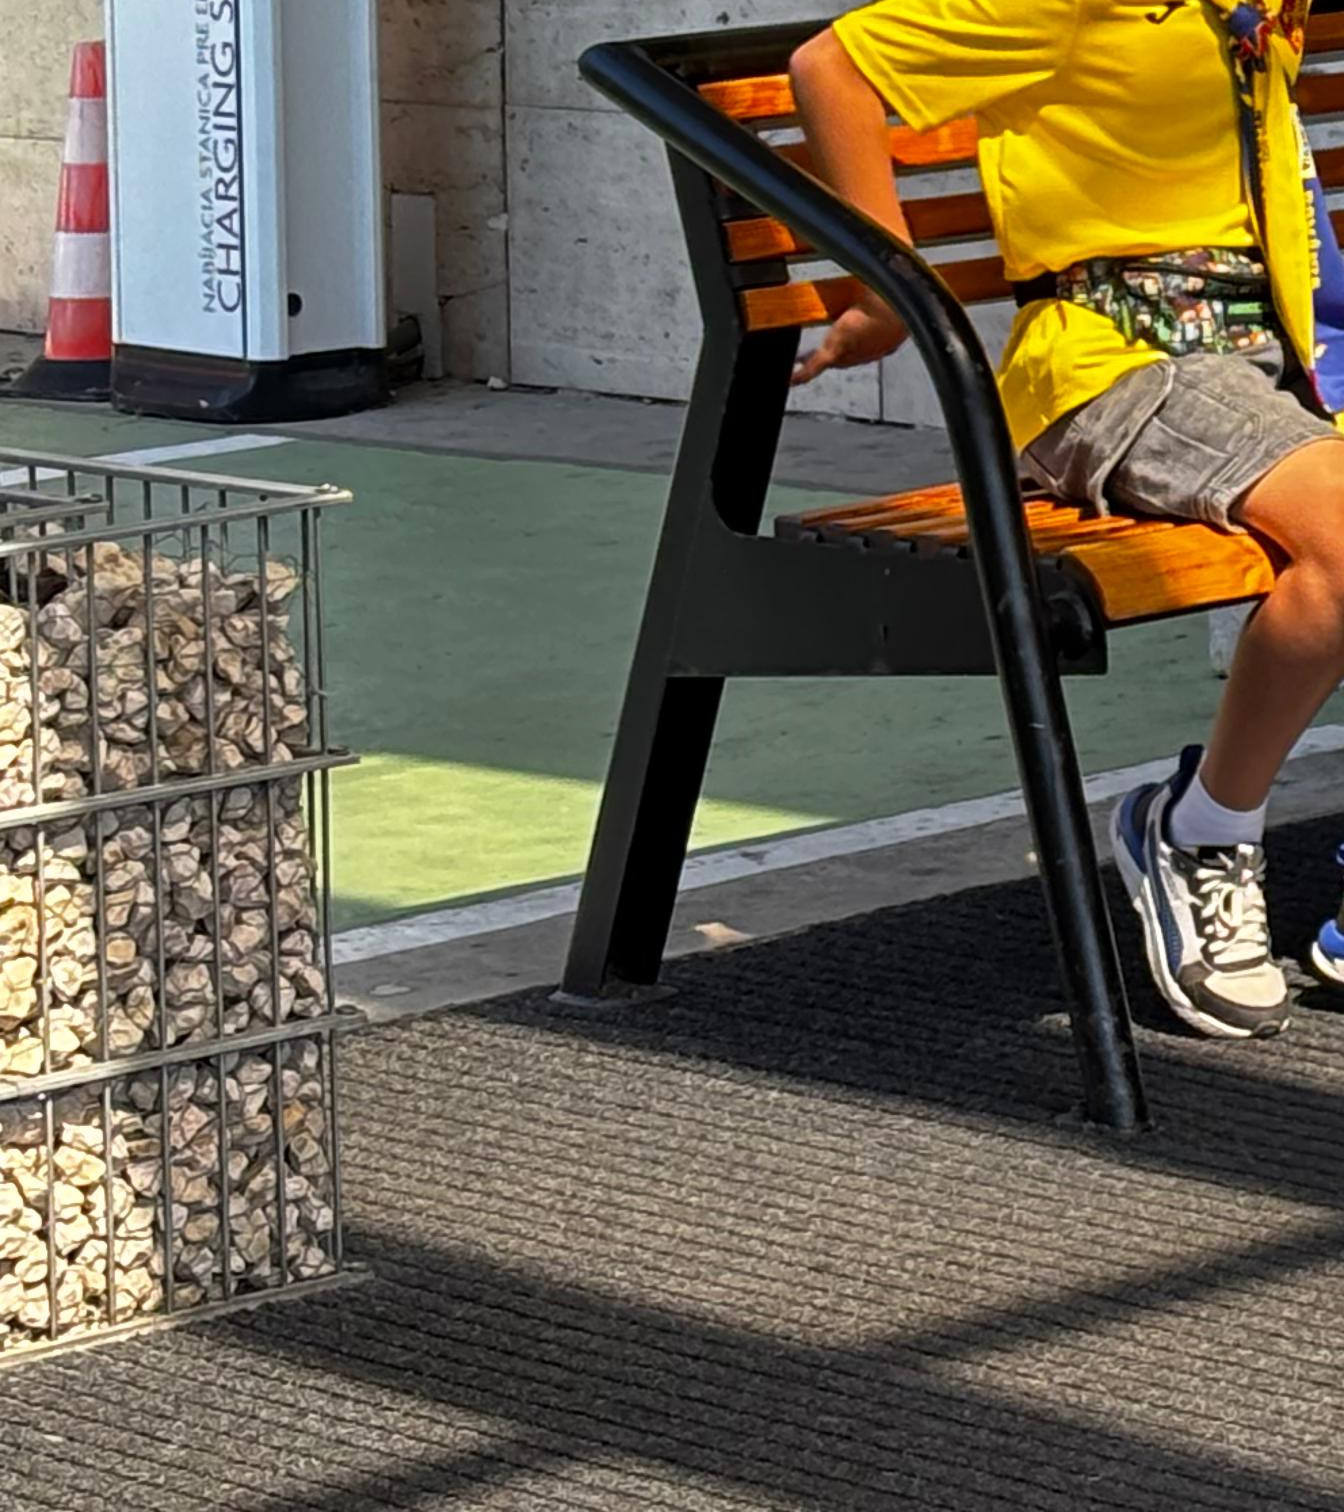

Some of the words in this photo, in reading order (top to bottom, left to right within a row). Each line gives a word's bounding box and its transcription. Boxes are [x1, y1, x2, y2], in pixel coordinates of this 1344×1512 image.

[196, 24, 210, 65] PRE
[198, 73, 212, 179] STANICA
[211, 42, 241, 313] CHARGING
